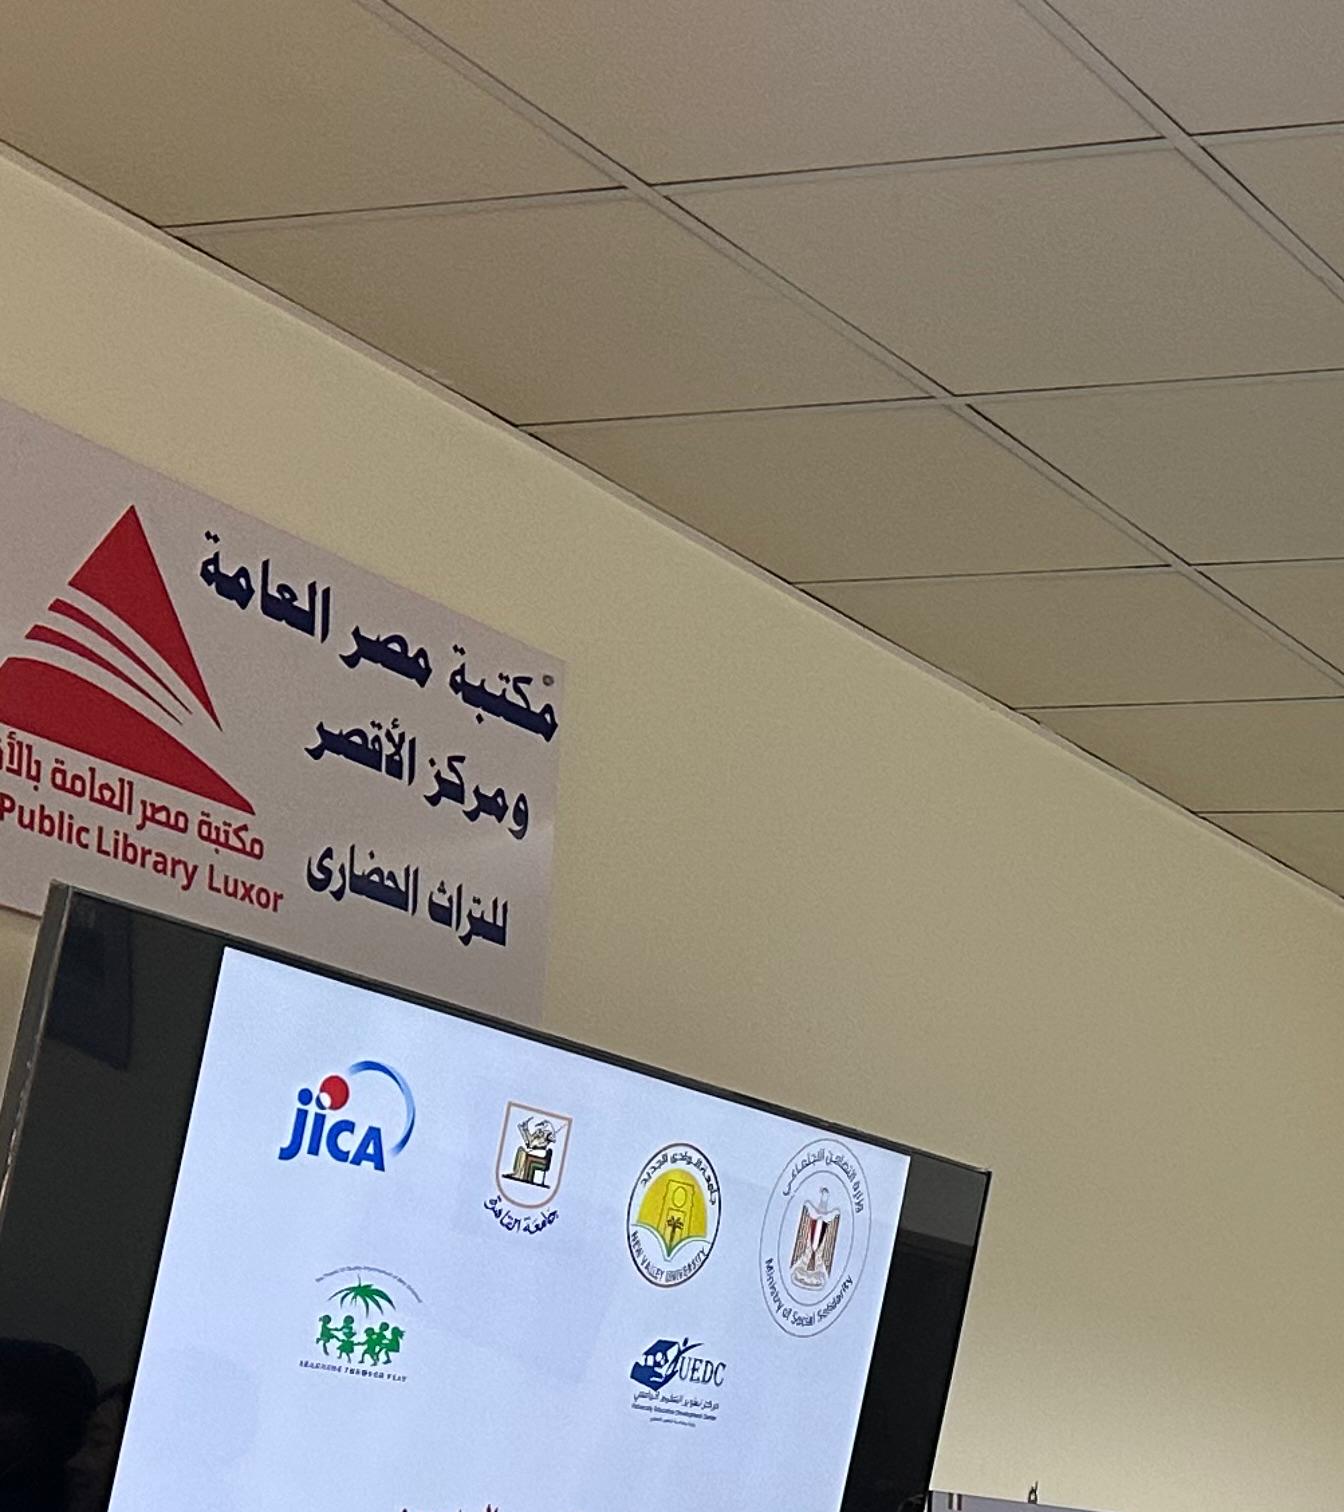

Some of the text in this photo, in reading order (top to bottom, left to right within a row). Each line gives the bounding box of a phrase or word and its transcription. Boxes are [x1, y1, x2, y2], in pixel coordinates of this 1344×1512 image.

[199, 530, 559, 743] مكتبة مصر العامة
[50, 757, 134, 816] العامة
[303, 717, 530, 840] ومركز الأقصر
[135, 797, 190, 836] مصر
[197, 812, 265, 861] مكتبة
[0, 791, 284, 914] Public Library Luxor
[427, 880, 509, 948] للتراث
[700, 1164, 718, 1206] جامعة
[522, 1207, 560, 1235] جامعة
[679, 1356, 727, 1388] UEDC
